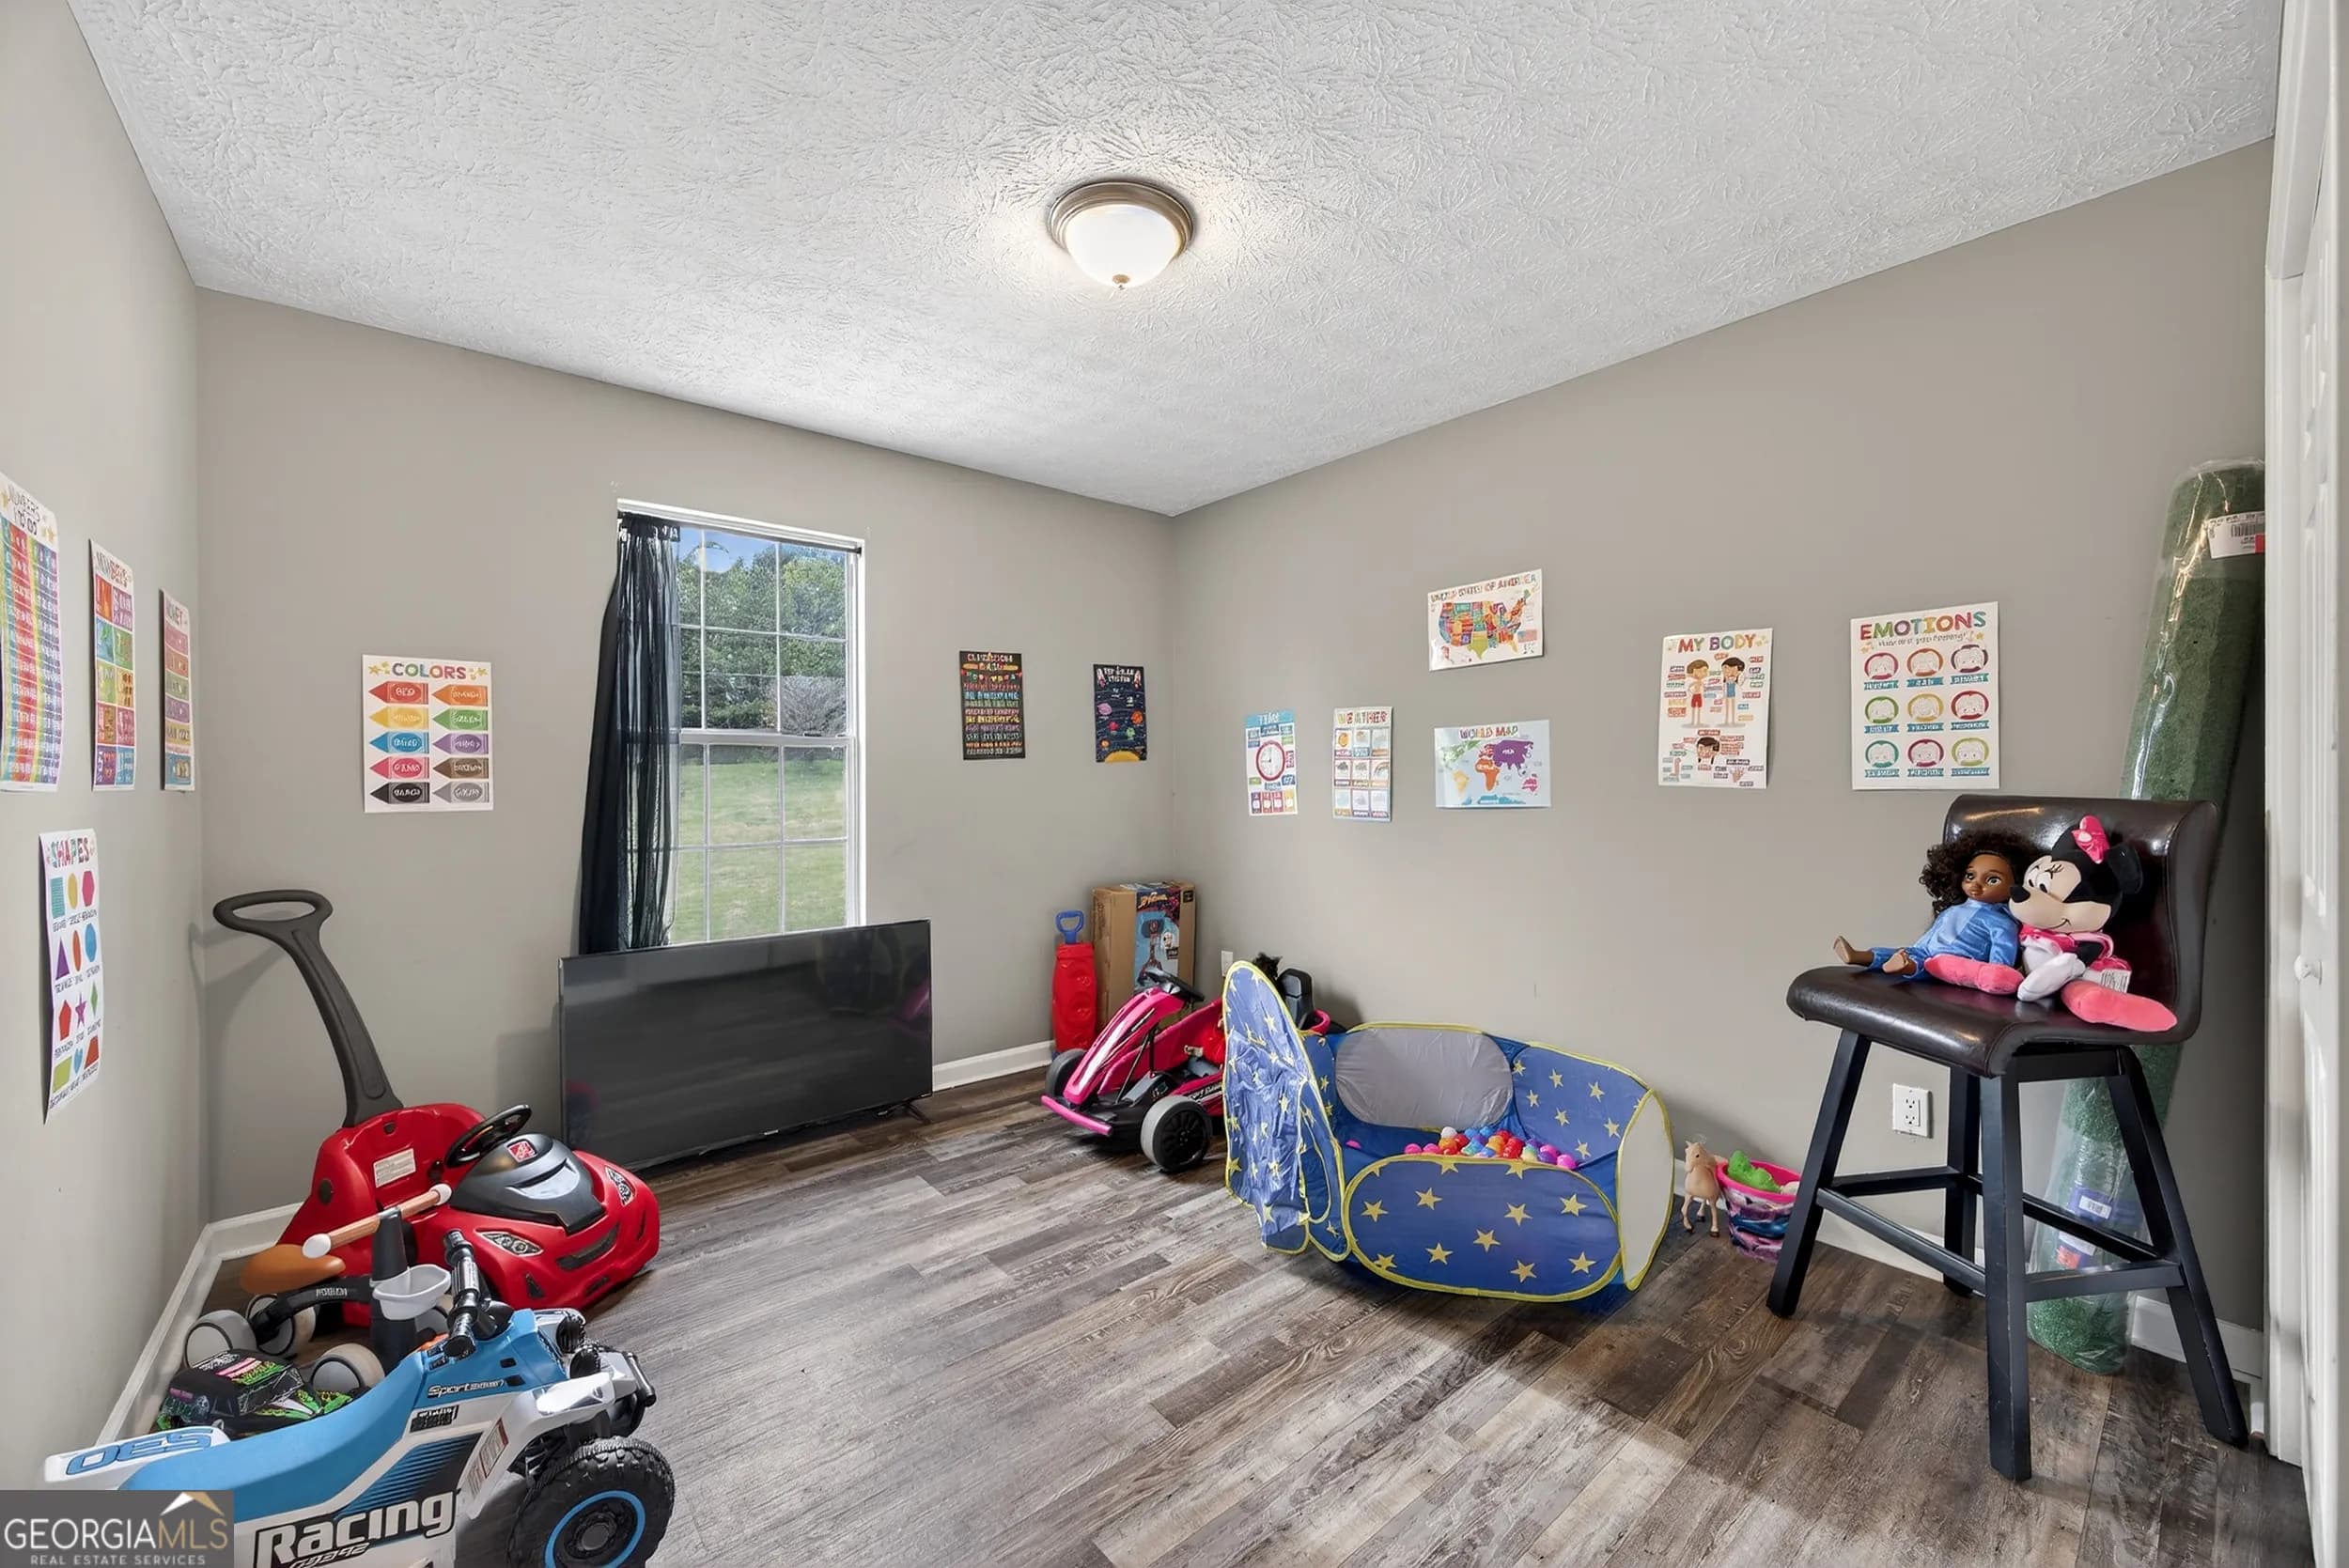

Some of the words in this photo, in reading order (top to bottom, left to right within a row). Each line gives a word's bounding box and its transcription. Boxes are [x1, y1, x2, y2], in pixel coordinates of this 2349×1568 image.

[1860, 611, 1986, 641] EMOTIONS
[1678, 637, 1704, 653] MY
[1709, 634, 1757, 651] BODY
[392, 661, 467, 680] COLORS
[1337, 710, 1388, 725] WEATHER
[1459, 727, 1493, 739] WORLD
[1495, 724, 1518, 737] MAP
[51, 836, 91, 868] SHAPES
[256, 1490, 458, 1568] Racing
